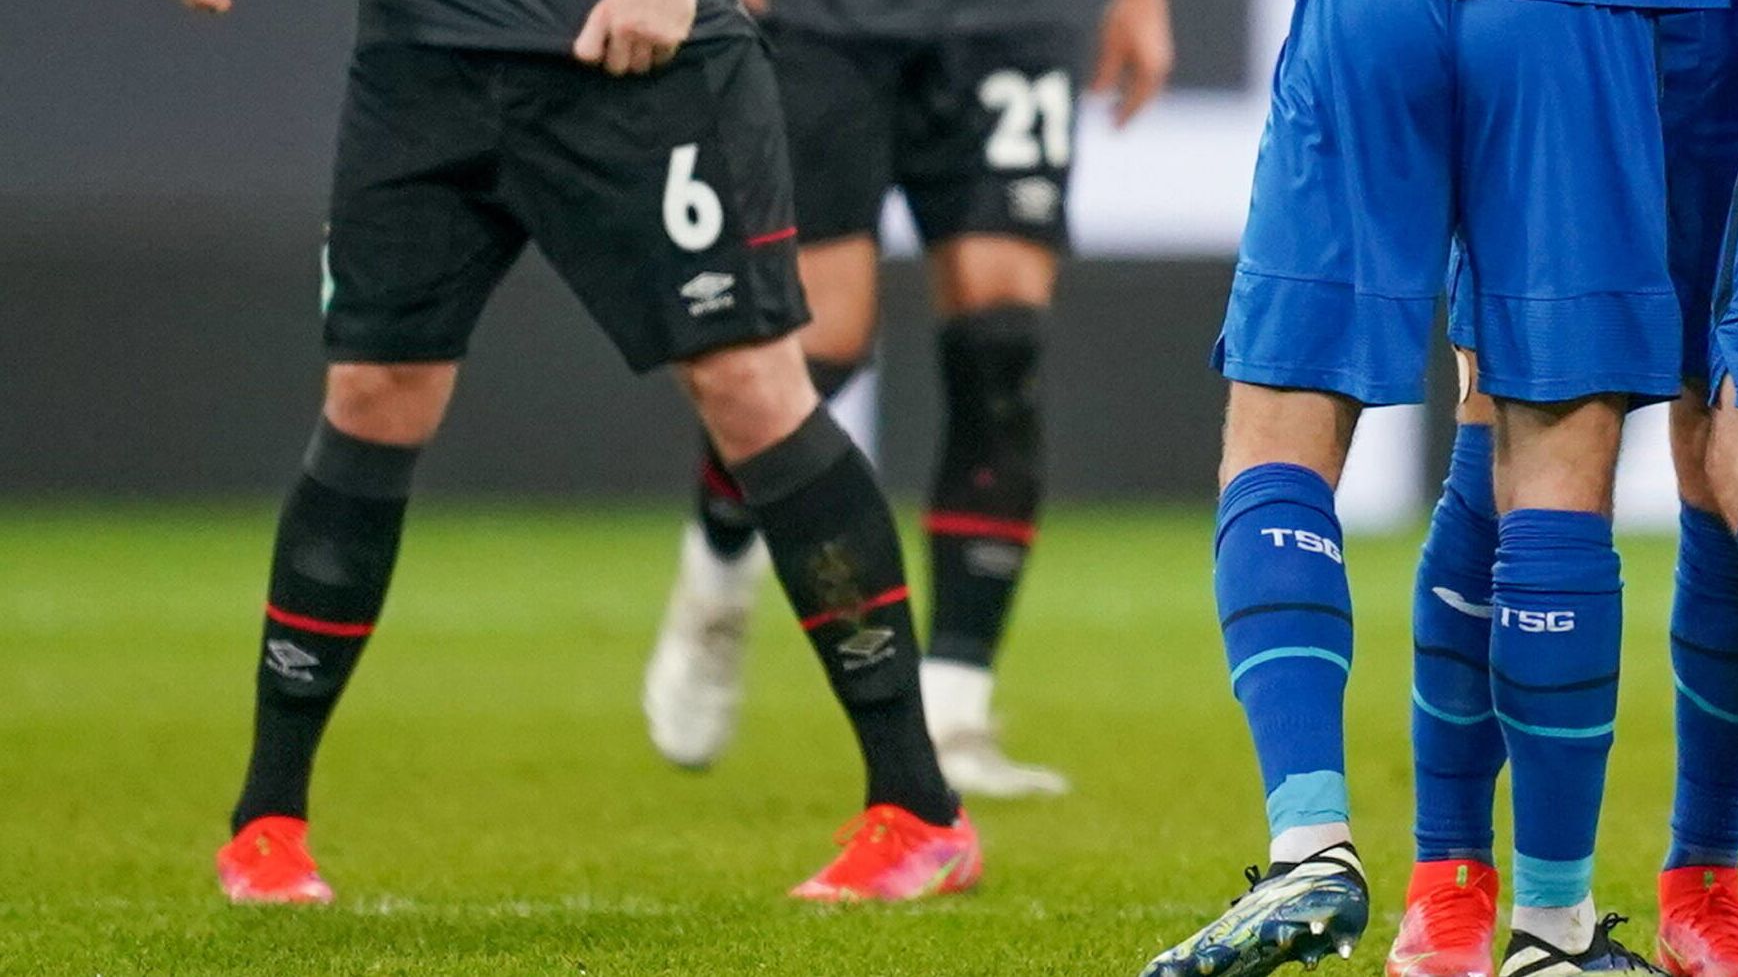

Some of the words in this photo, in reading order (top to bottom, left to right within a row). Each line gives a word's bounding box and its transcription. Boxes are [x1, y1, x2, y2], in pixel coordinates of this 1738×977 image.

[977, 68, 1071, 169] 21
[662, 142, 724, 252] 6
[1261, 527, 1343, 565] TSG
